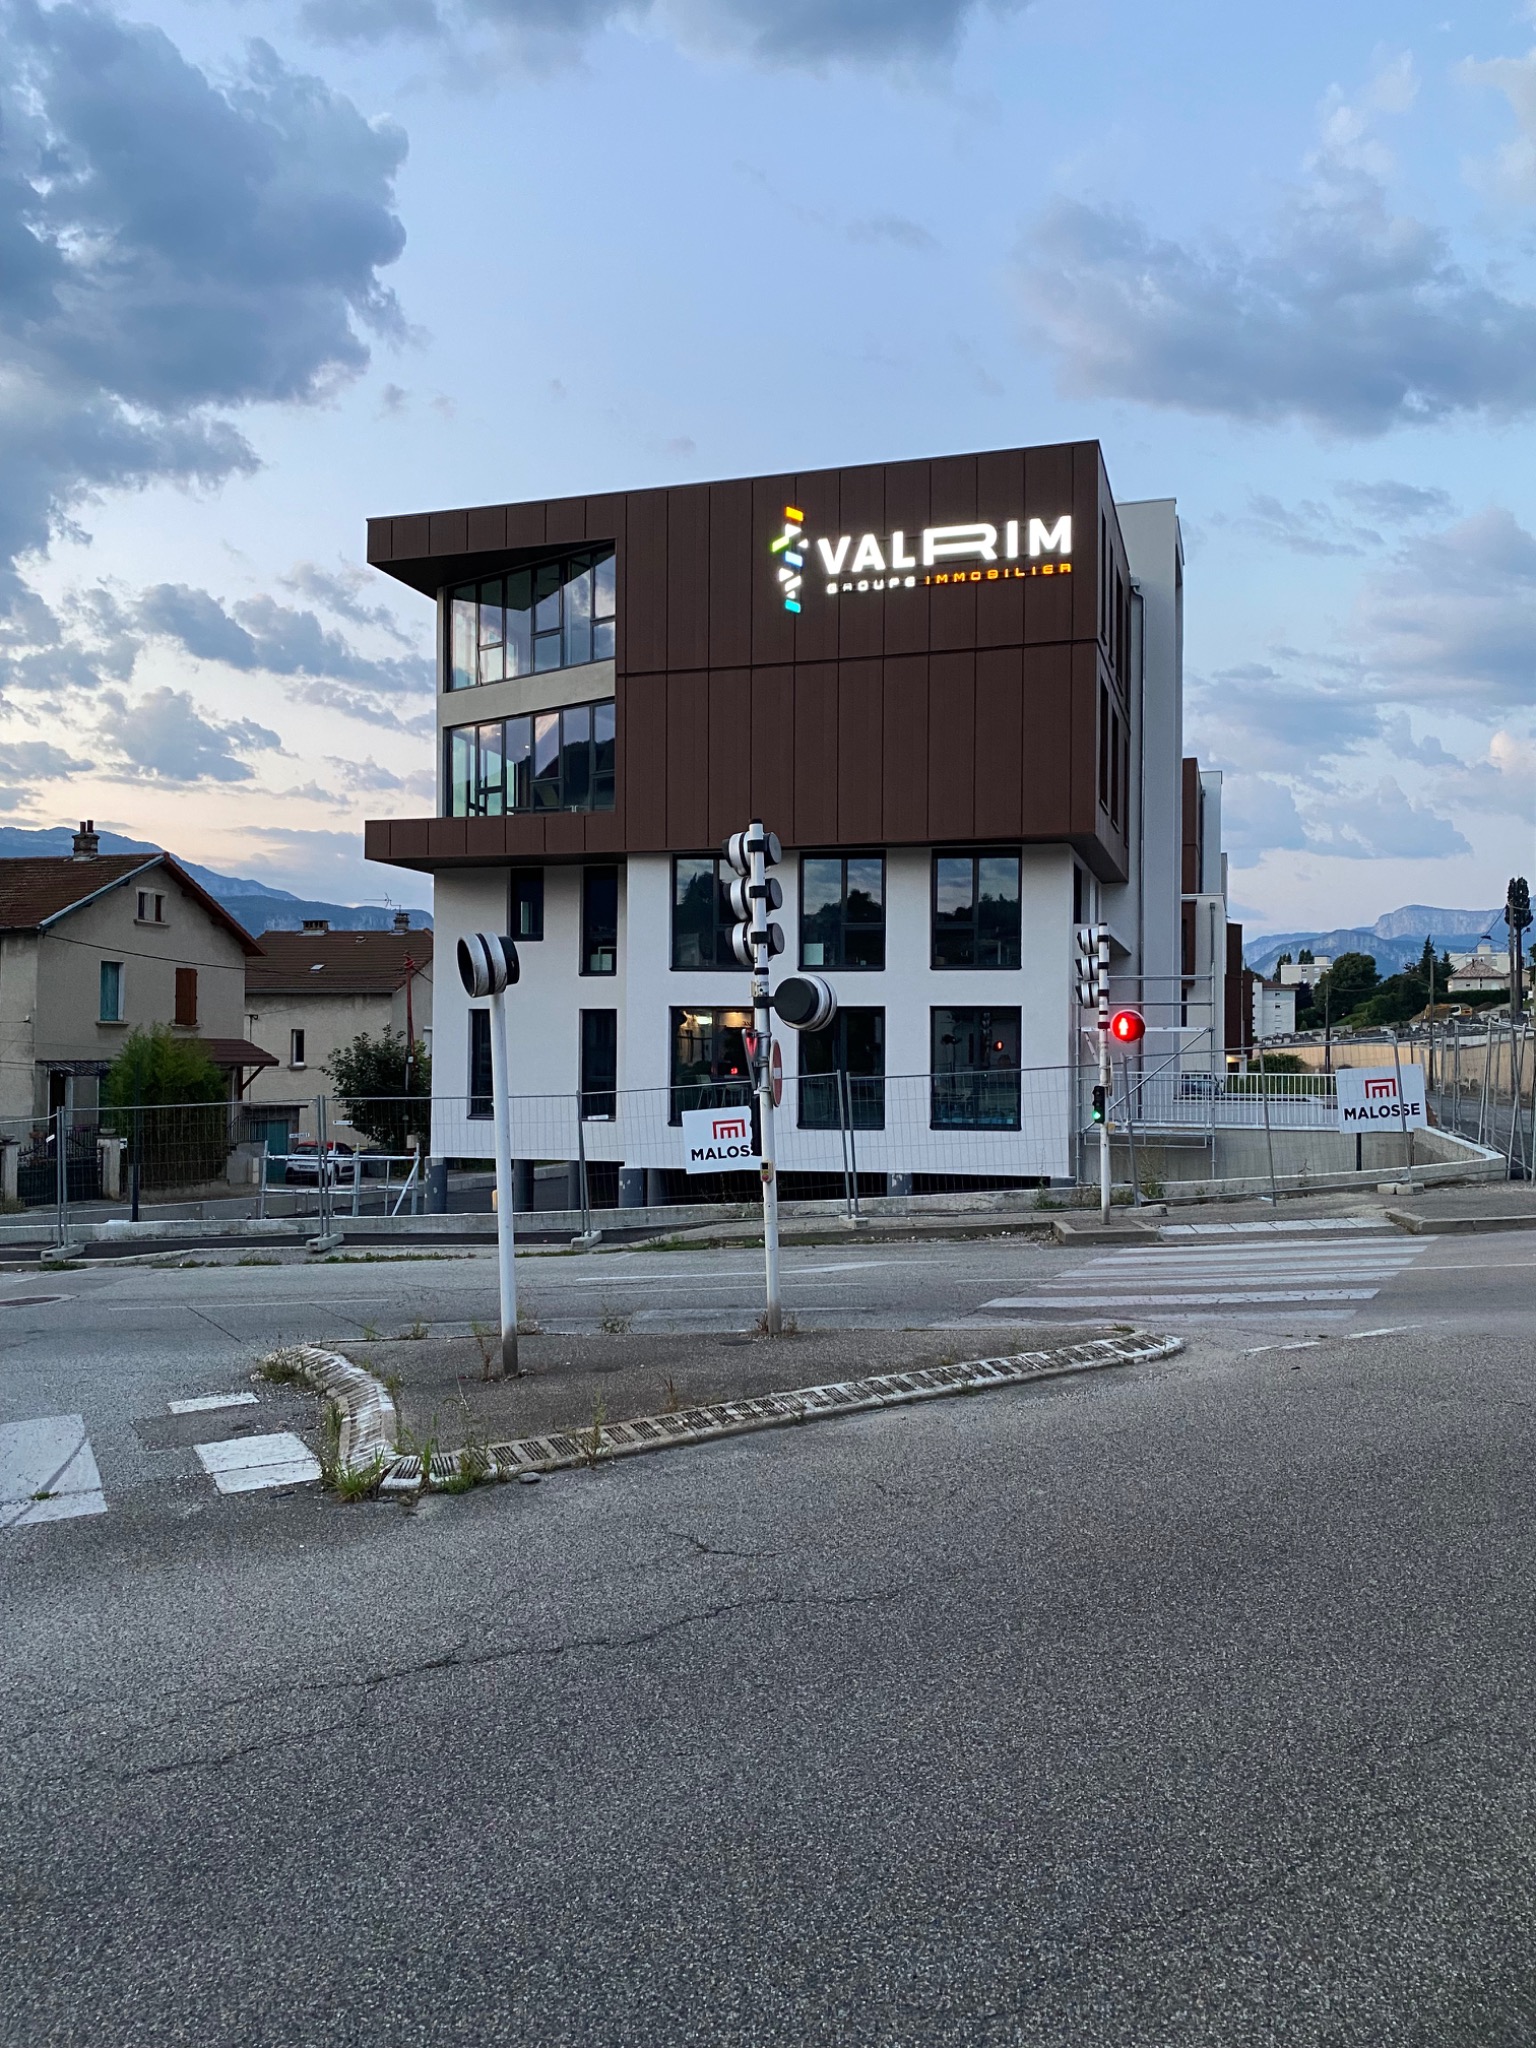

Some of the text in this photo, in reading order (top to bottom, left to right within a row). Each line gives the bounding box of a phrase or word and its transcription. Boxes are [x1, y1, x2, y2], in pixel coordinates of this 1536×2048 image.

[817, 515, 1072, 575] VALRIM
[826, 563, 1072, 595] GROUPE IMMOBILIER
[1344, 1102, 1421, 1121] MALOSSE
[691, 1144, 751, 1162] MALOS
